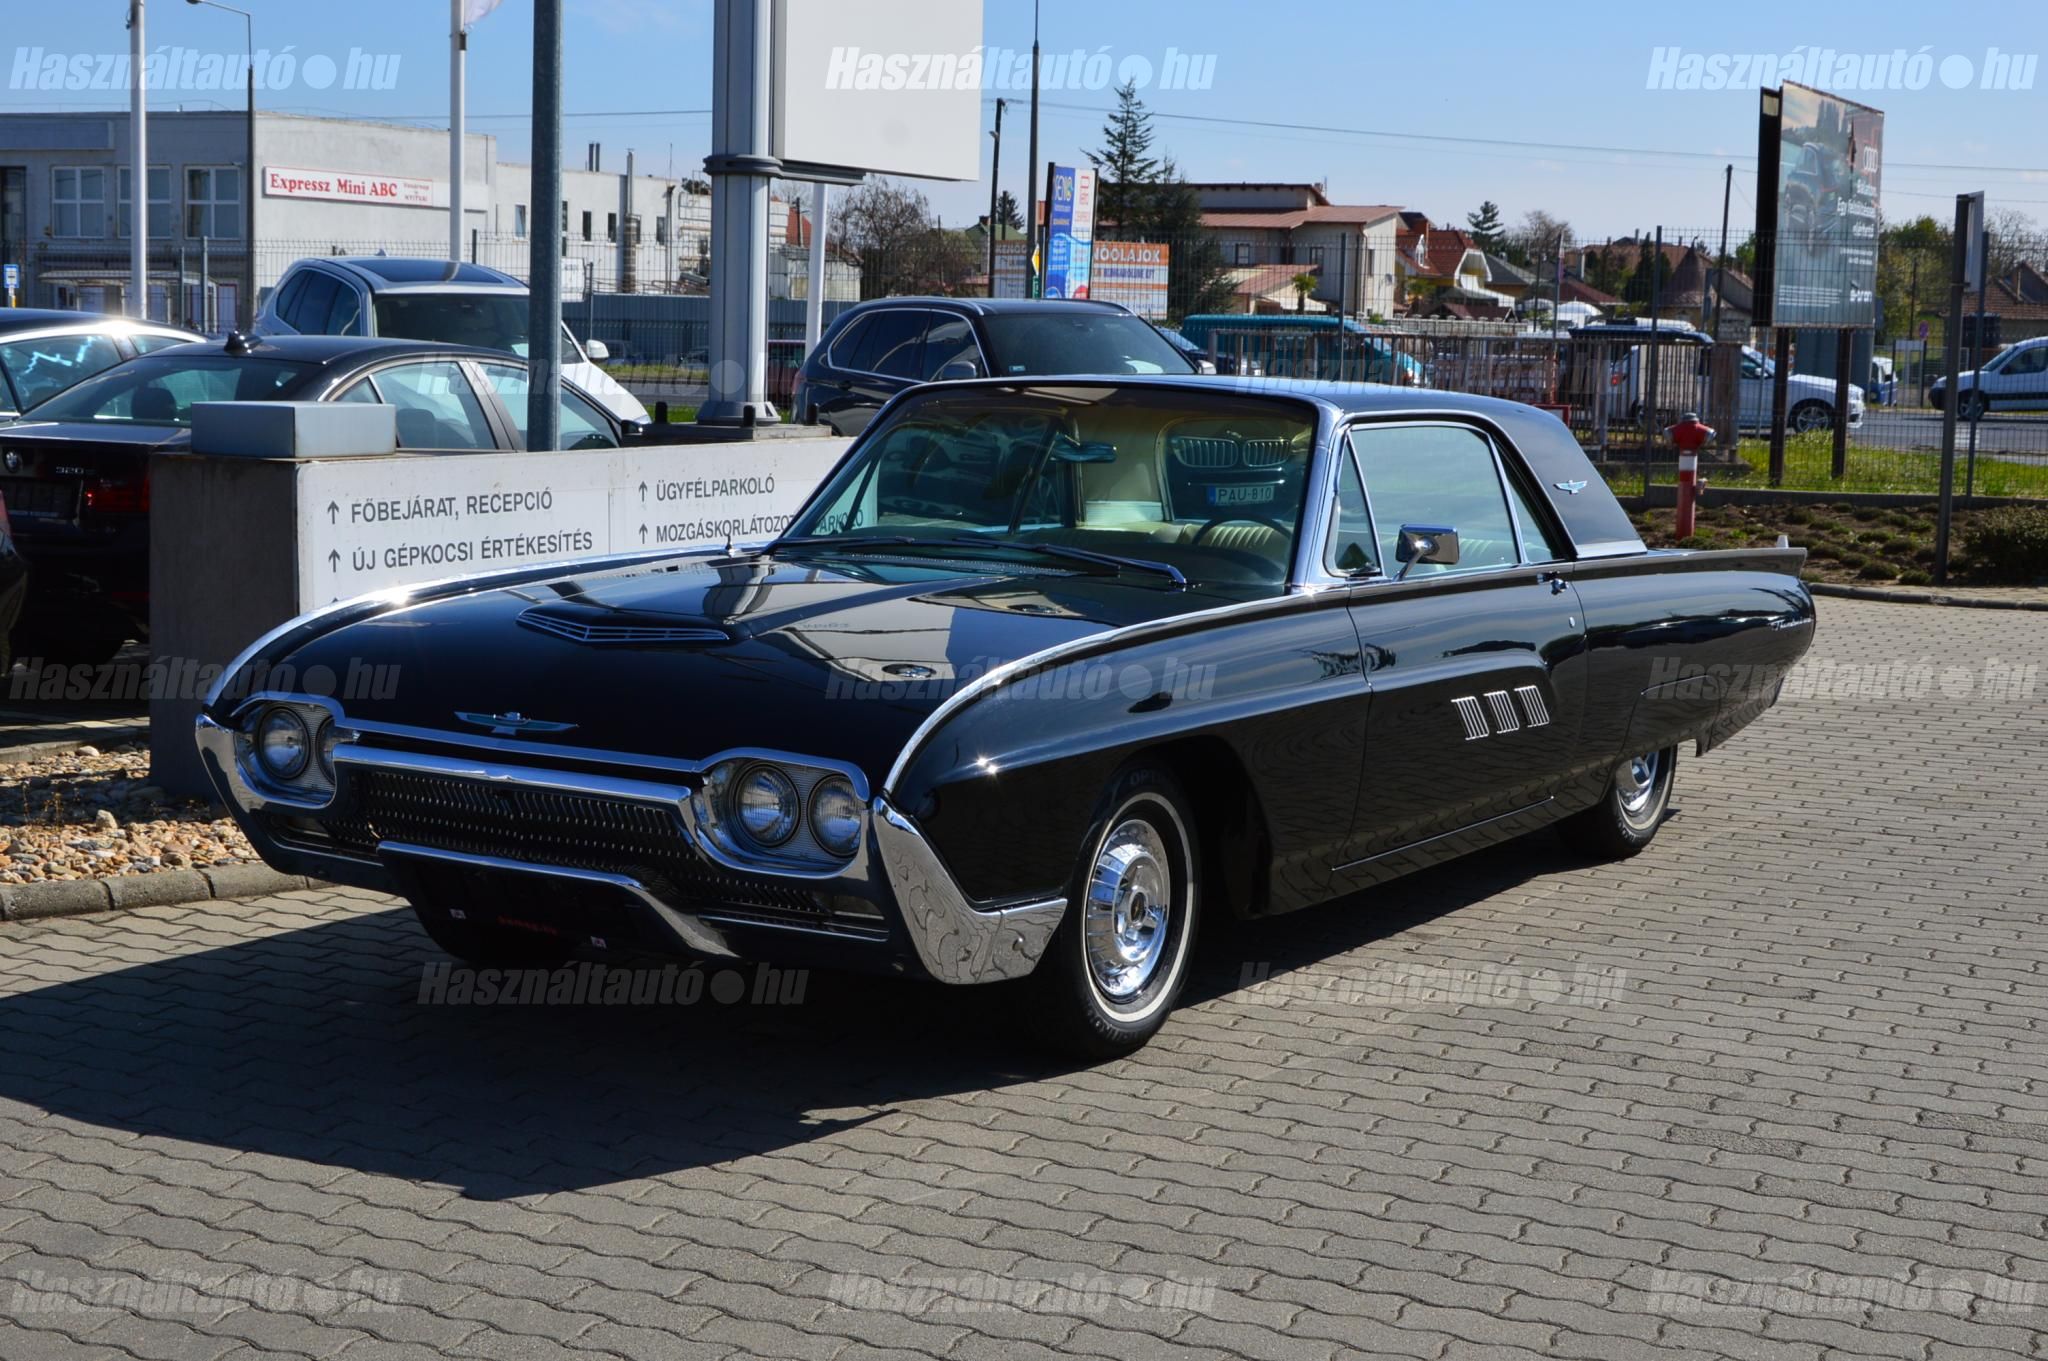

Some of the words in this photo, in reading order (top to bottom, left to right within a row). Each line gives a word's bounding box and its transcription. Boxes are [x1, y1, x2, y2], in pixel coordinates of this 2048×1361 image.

[270, 173, 331, 192] Expressz
[337, 178, 366, 195] Mini
[369, 182, 398, 197] ABC
[656, 473, 775, 502] ÜGYFÉLPARKOLÓ
[1218, 486, 1272, 502] PAU-810
[351, 494, 459, 524] FŐBEJÁRAT,
[466, 487, 553, 516] RECEPCIÓ
[352, 547, 376, 572] ÚJ
[384, 542, 474, 569] GÉPKOCSI
[481, 529, 593, 560] ÉRTÉKESÍTÉS
